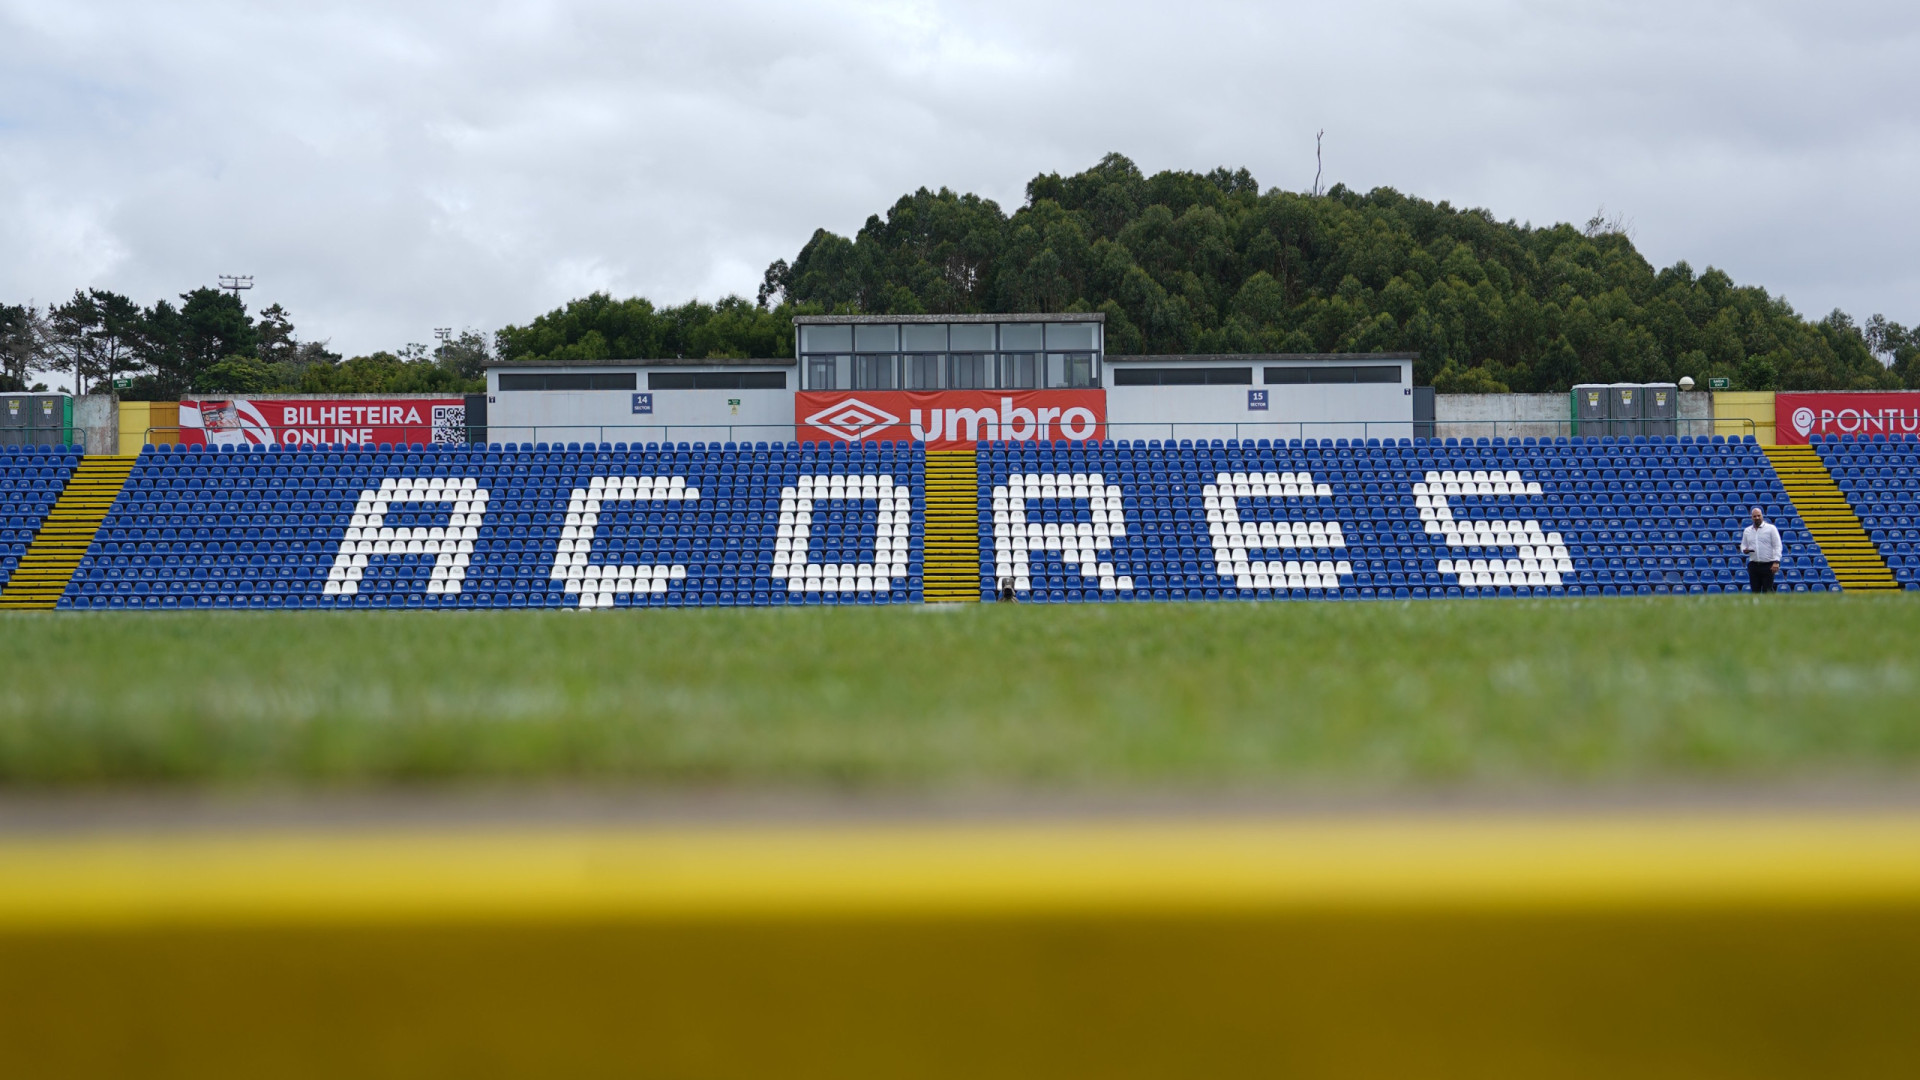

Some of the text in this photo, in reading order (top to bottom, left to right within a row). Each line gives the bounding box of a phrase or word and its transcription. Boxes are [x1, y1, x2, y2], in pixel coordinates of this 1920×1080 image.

[637, 395, 648, 404] 14
[1253, 392, 1264, 401] 15
[283, 406, 422, 425] BILHETEIRA
[910, 397, 1096, 442] umbro
[1821, 408, 1920, 432] PONTU
[283, 429, 373, 447] ONLINE
